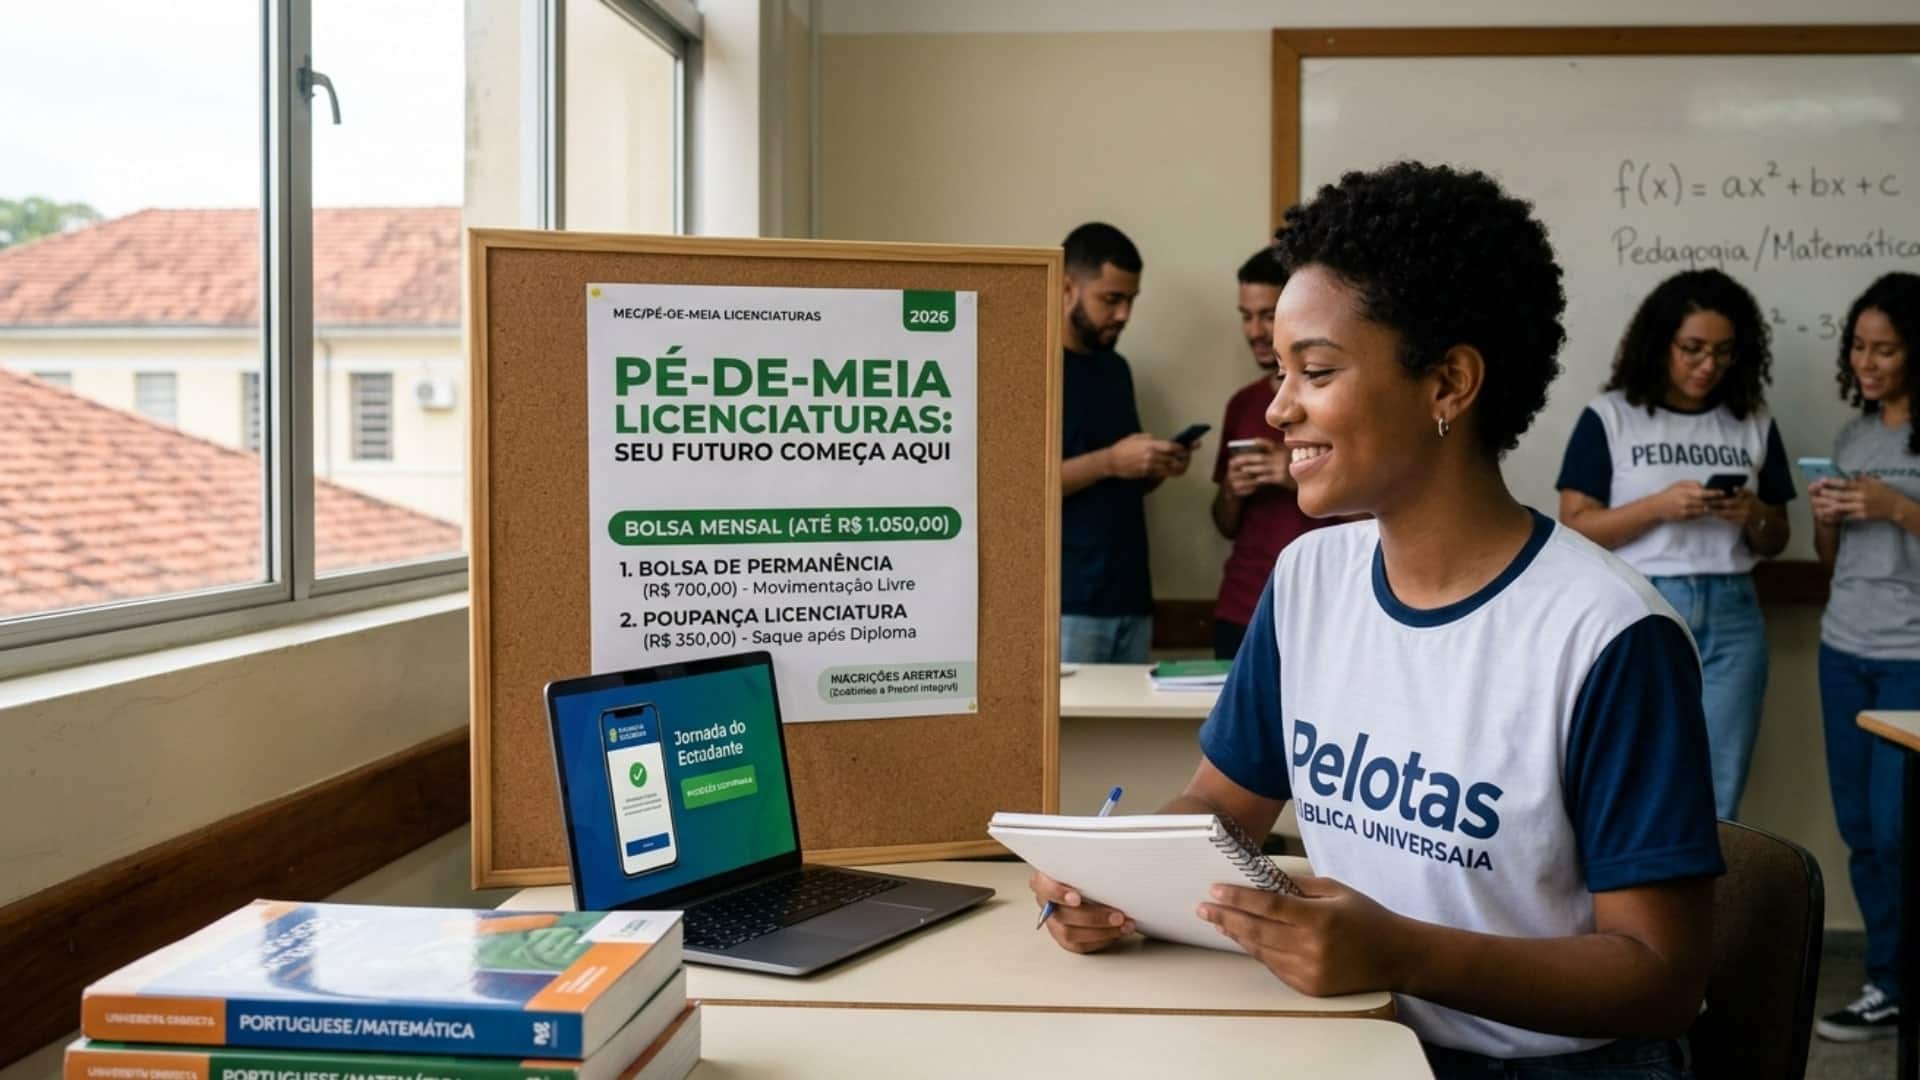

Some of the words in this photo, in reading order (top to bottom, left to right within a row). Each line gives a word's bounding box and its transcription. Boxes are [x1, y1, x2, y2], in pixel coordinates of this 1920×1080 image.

[724, 309, 821, 322] LICENCIATURAS
[910, 309, 949, 324] 2026
[615, 346, 952, 398] PÉ-DE-MEIA
[615, 404, 952, 434] LICENCIATURAS:
[614, 443, 663, 461] SEU
[672, 442, 773, 461] FUTURO
[780, 442, 886, 465] COMEÇA
[892, 442, 950, 463] AQUI
[1631, 443, 1753, 467] PEDAGOGIA
[625, 519, 694, 537] BOLSA
[700, 518, 783, 535] MENSAL
[788, 513, 833, 537] (ATÉ
[838, 516, 863, 535] R$
[866, 514, 949, 535] 1.050,00)
[619, 562, 633, 577] 1.
[639, 560, 708, 577] BOLSA
[714, 558, 741, 575] DE
[747, 553, 893, 574] PERMANÊNCIA
[643, 581, 671, 600] (R$
[674, 580, 738, 599] 700,00)
[753, 578, 873, 596] Movimentação
[877, 577, 916, 592] Livre
[619, 612, 637, 628] 2.
[643, 607, 760, 628] POUPANÇA
[764, 604, 908, 623] LICENCIATURA
[643, 632, 672, 651] (R$
[675, 631, 737, 649] 350,00)
[752, 630, 803, 649] Saque
[850, 625, 917, 645] Diploma
[673, 722, 728, 746] Jornada
[729, 719, 747, 736] do
[1293, 719, 1504, 840] Pelotas
[1299, 798, 1358, 835] BLICA
